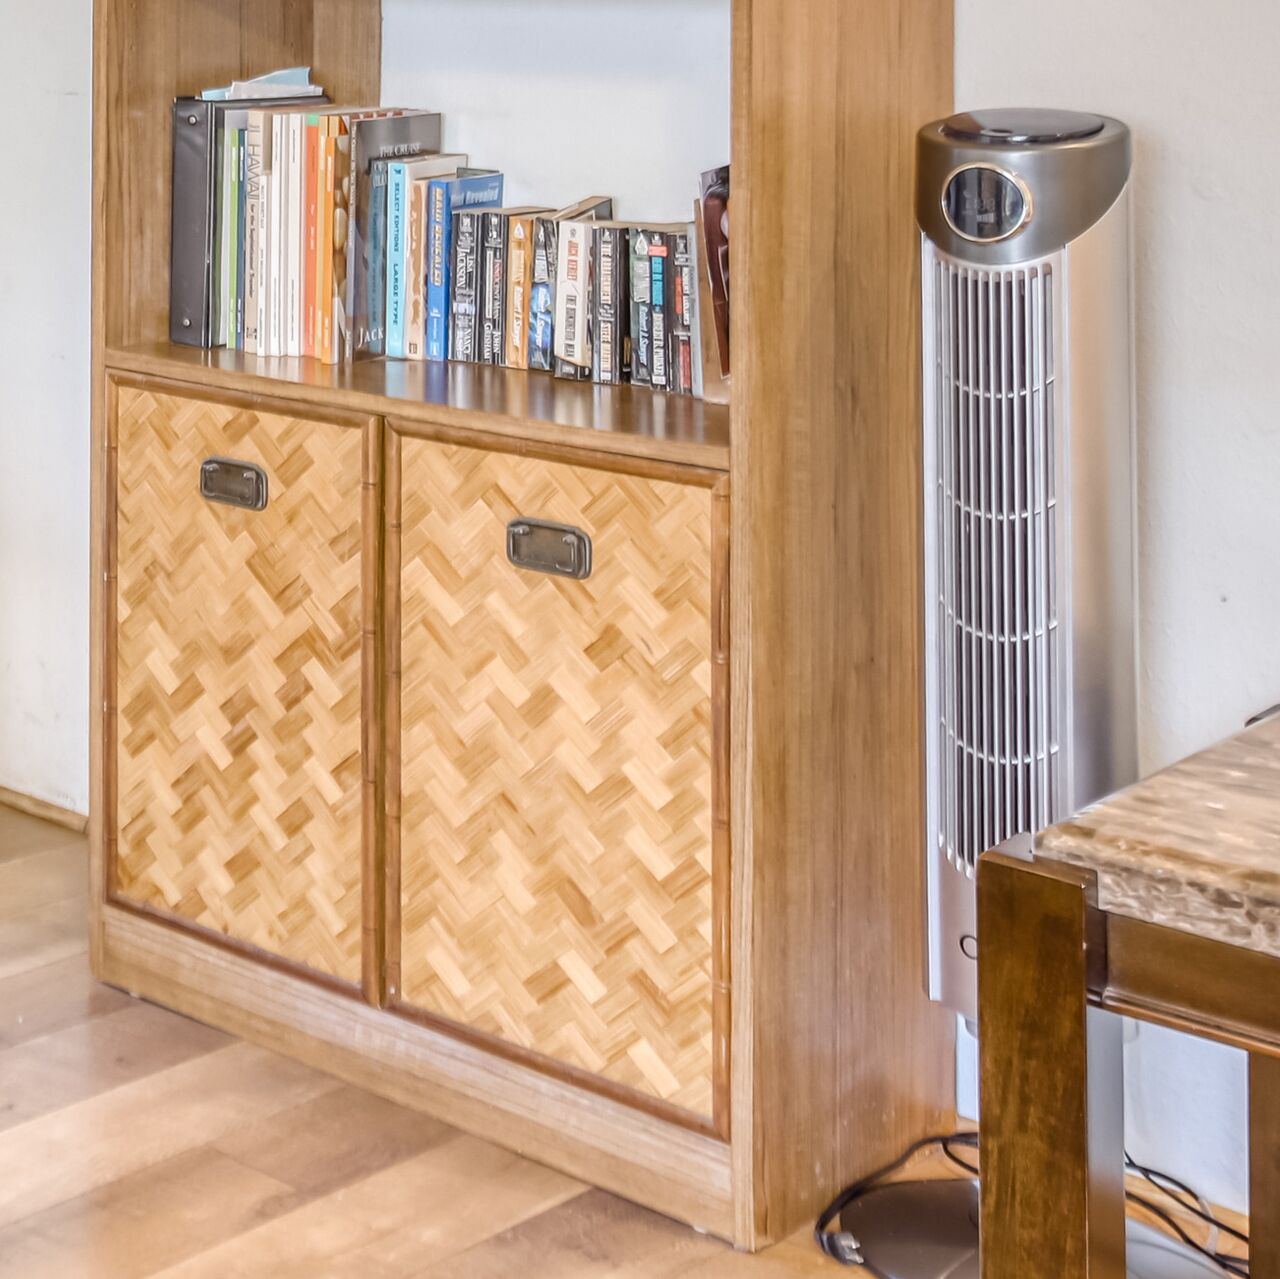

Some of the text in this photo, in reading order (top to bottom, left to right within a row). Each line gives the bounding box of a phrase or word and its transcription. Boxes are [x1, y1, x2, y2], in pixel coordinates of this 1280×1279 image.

[248, 144, 260, 200] HAWAII
[456, 246, 470, 289] JACKSON
[467, 255, 475, 273] LISA
[358, 326, 384, 348] JACK
[463, 327, 471, 355] NANCY
[483, 322, 492, 360] GRISHAM
[492, 330, 501, 354] JOHN
